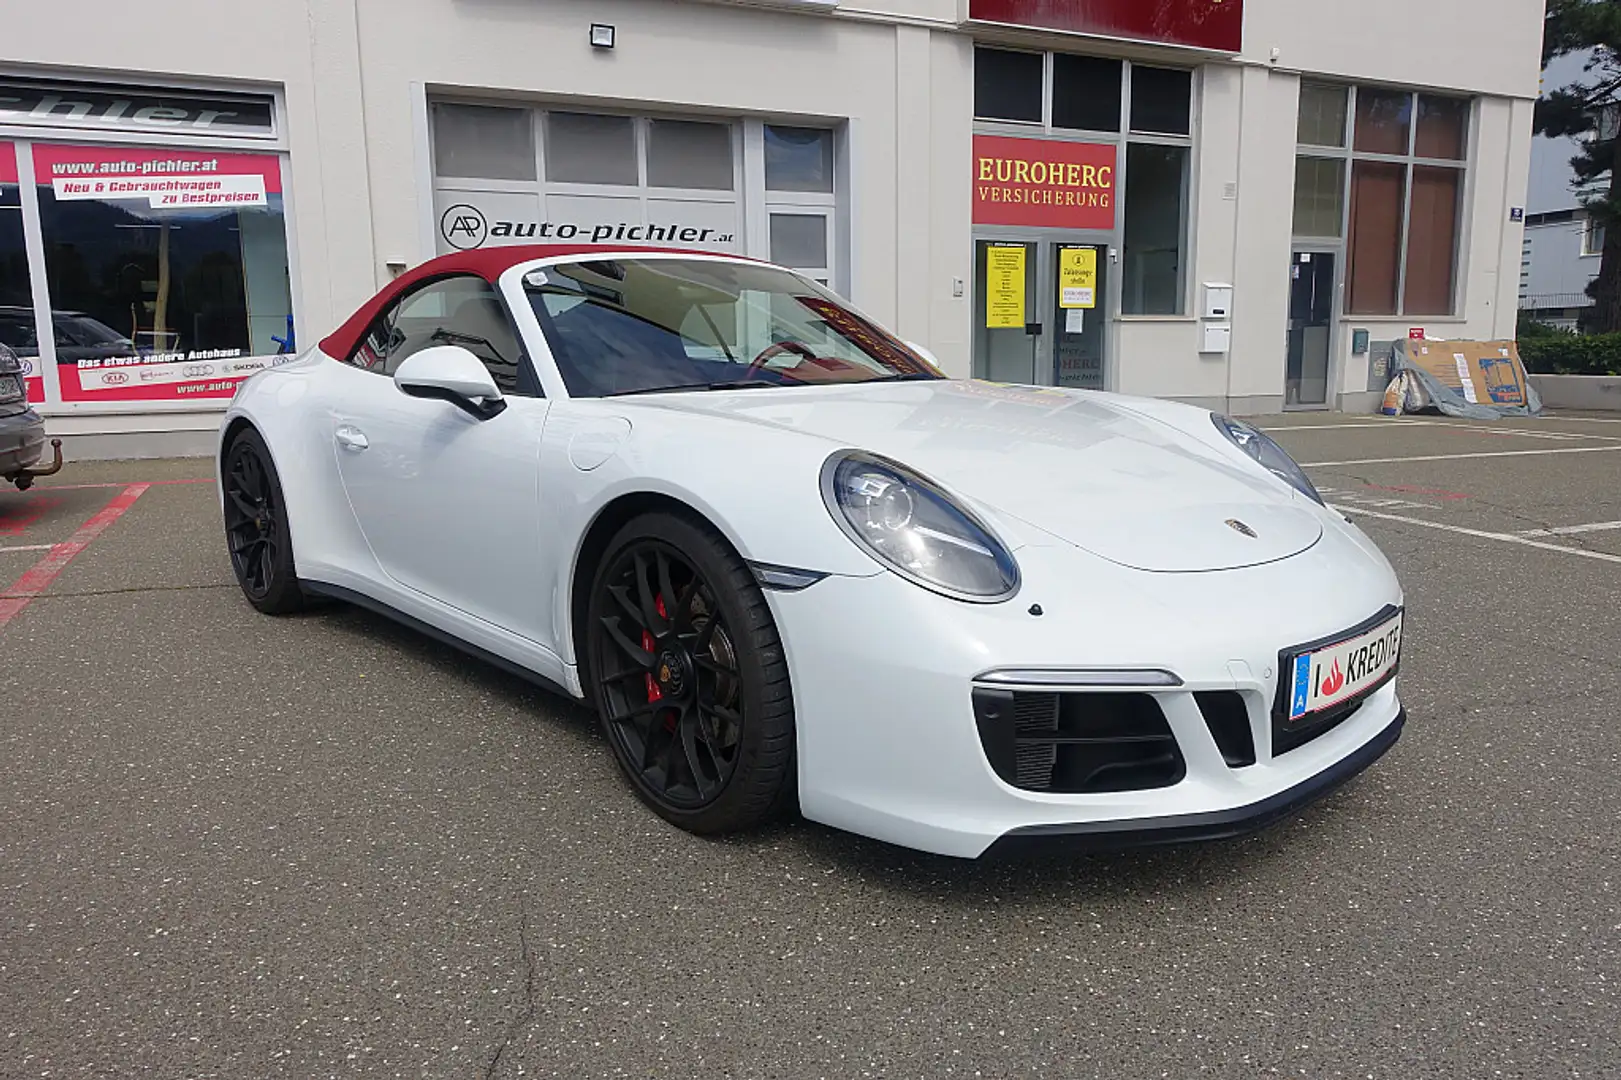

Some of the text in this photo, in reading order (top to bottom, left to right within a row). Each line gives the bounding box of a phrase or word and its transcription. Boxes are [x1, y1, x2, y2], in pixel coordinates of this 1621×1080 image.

[0, 94, 237, 128] hler
[52, 158, 218, 175] www.auto-pichler.at
[978, 158, 1111, 188] EUROHERC
[63, 179, 222, 193] Neu & Gebrauchtwagen
[162, 192, 260, 204] zu Bestpreisen
[978, 186, 1109, 208] VERSICHERUNG
[77, 348, 240, 369] Das etwas andere Autohaus
[1345, 625, 1399, 685] KREDITE
[1295, 694, 1304, 709] A
